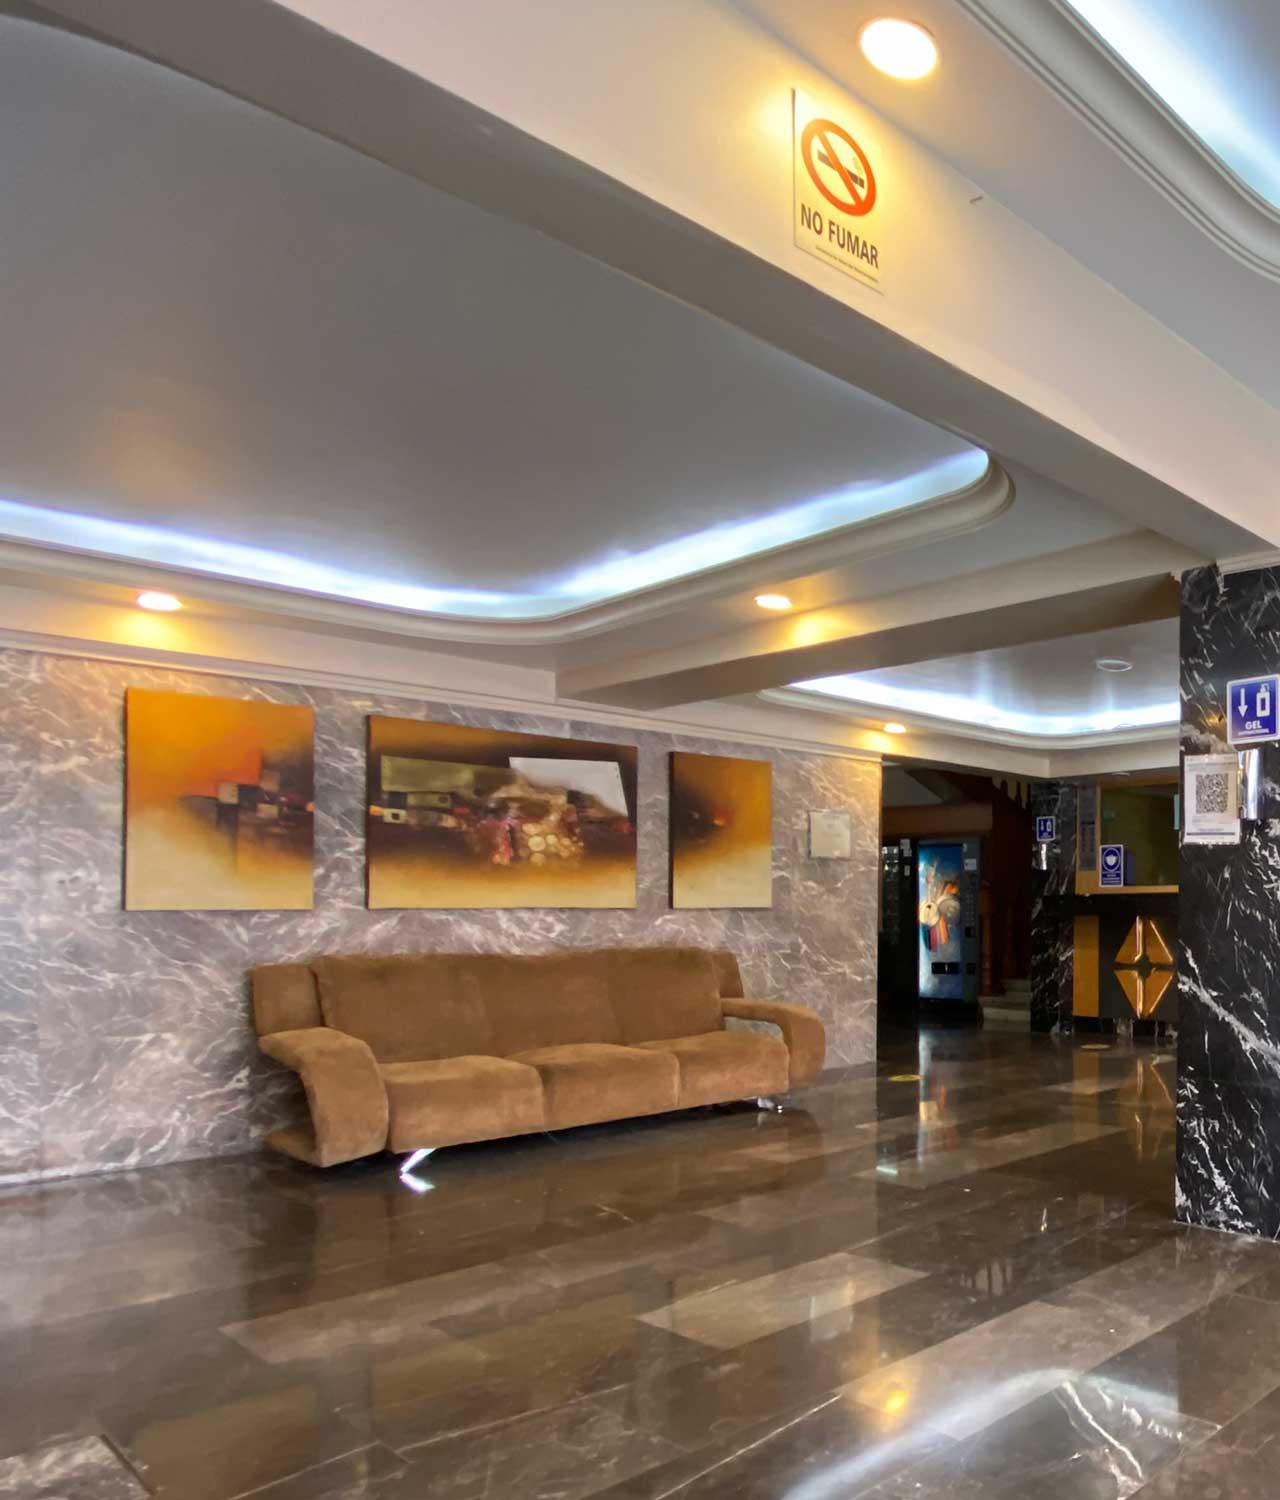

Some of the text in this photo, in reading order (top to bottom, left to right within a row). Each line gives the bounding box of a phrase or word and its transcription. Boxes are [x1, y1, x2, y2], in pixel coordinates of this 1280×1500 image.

[801, 203, 823, 235] NO
[828, 219, 879, 269] FUMAR
[1245, 720, 1262, 730] GEL
